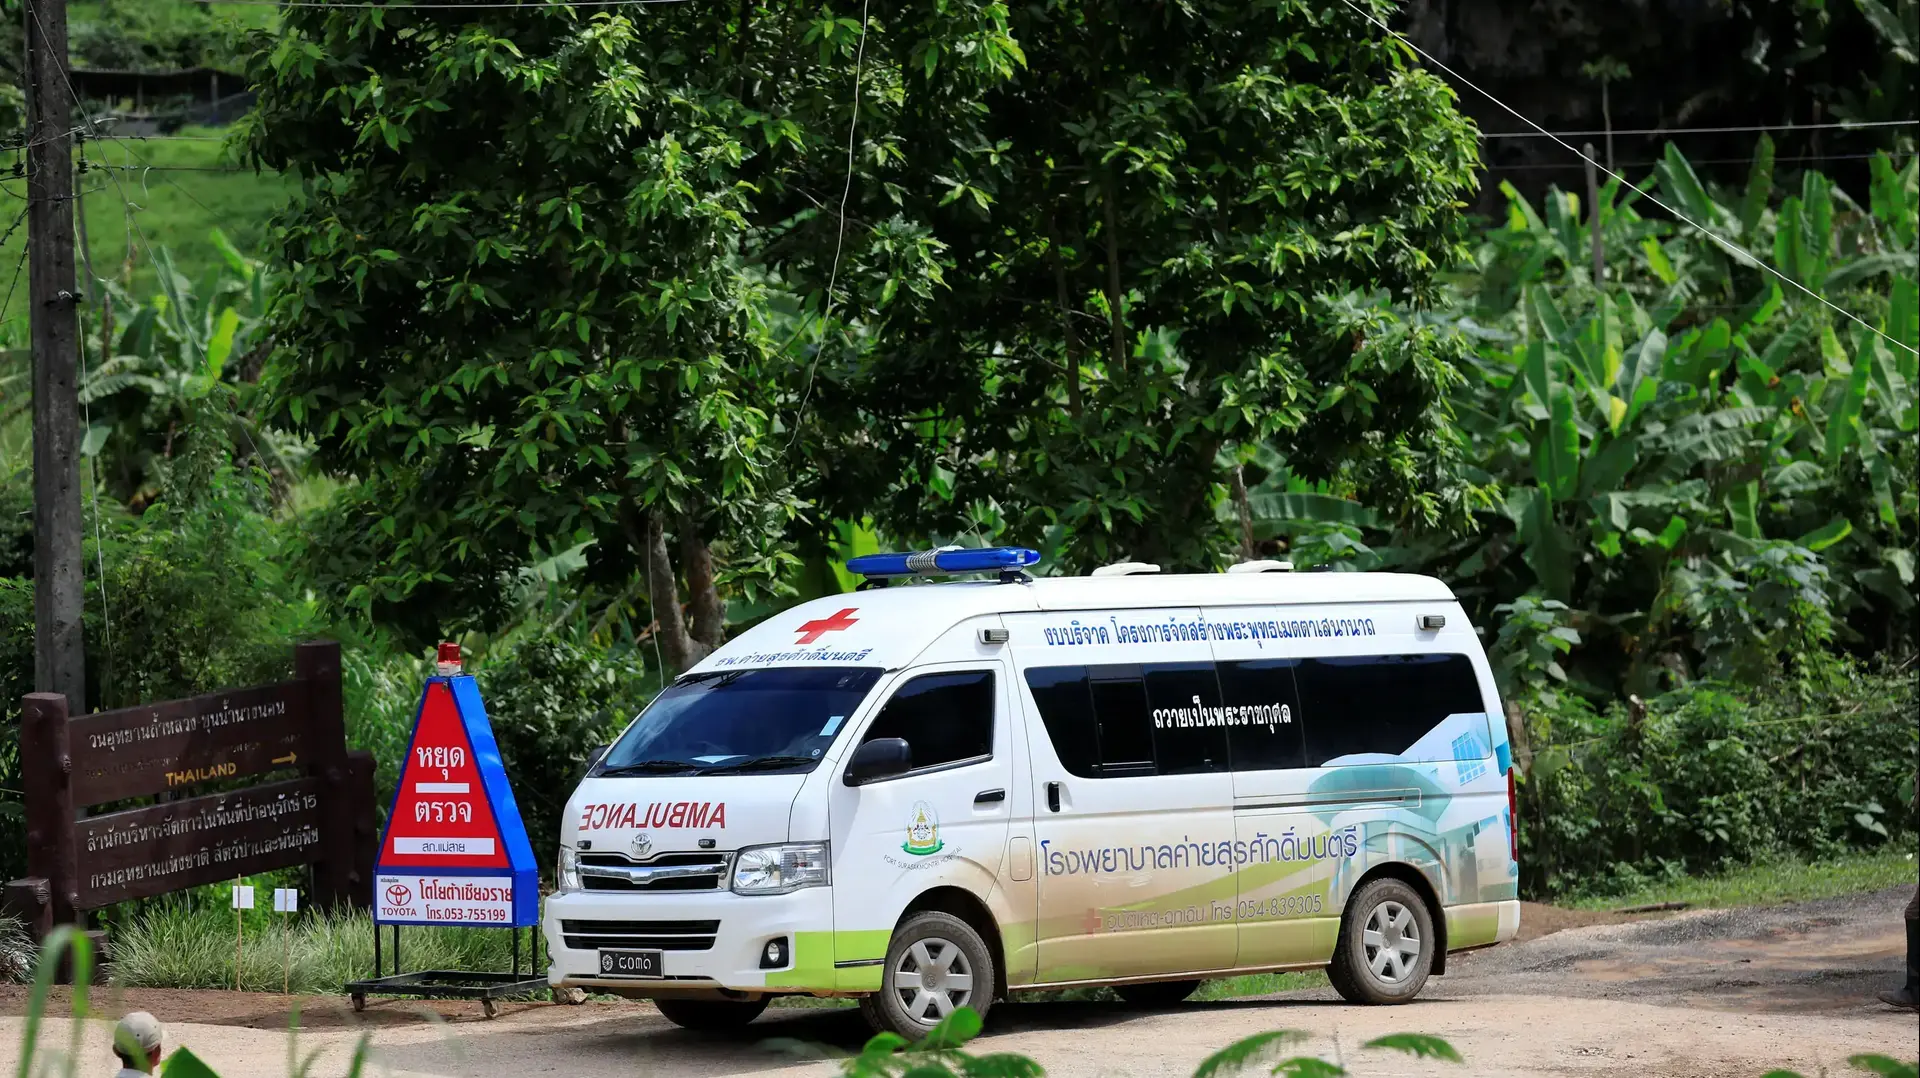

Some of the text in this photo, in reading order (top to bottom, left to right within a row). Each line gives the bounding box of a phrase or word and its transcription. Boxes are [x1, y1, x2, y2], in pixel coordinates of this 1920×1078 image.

[1043, 619, 1110, 646] งบบริจาค
[1153, 695, 1292, 734] ถวายเป็นพระราชกุศล
[165, 762, 237, 786] THAILAND
[416, 746, 465, 781] หยุด
[302, 794, 317, 811] 15
[415, 801, 472, 823] ตรวจ
[422, 841, 465, 853] สภ.แม่สาย
[1041, 826, 1358, 877] โรงพยาบาลค่ายสุรศักดิ์มนตรี
[419, 878, 513, 902] โตโยต้าเชียงราย
[381, 907, 417, 916] TOYOTA
[425, 904, 506, 921] โทร.053-755199
[1237, 895, 1322, 919] 054-839305
